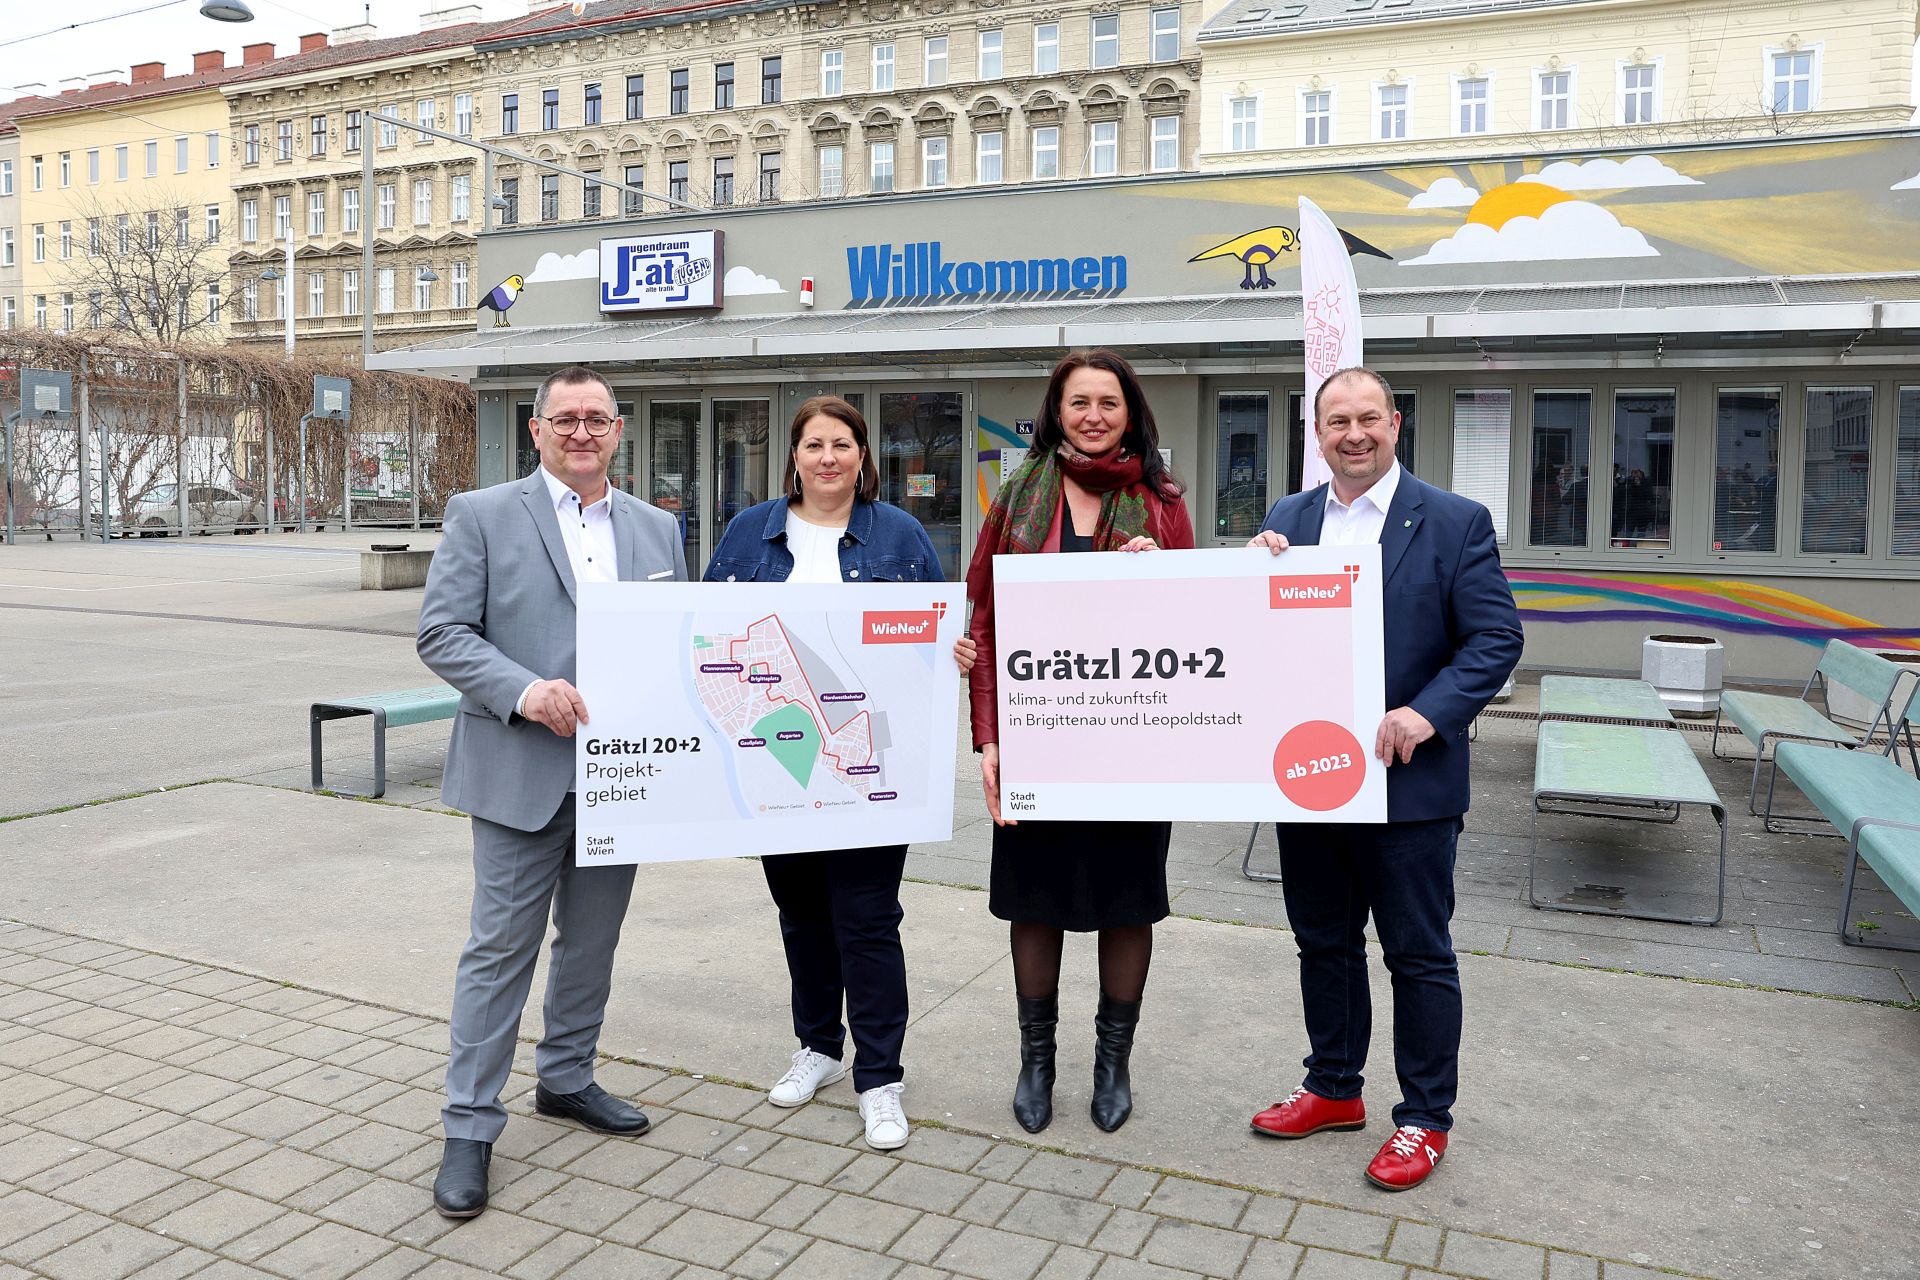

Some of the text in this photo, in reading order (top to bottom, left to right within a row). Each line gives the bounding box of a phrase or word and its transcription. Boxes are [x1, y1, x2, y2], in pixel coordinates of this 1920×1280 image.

[678, 259, 710, 284] JUGEND
[847, 241, 1127, 299] Willkommen
[1019, 424, 1030, 434] 8A
[1279, 584, 1342, 600] WieNeu+
[871, 619, 929, 636] WieNeu+
[1007, 647, 1226, 681] Grätzl 20+2
[823, 692, 863, 701] Nordwestbahnhof
[1009, 691, 1168, 706] klima- und zukunftsfit
[1009, 711, 1243, 730] in Brigittenau und Leopoldstadt
[779, 732, 801, 740] Augarten
[585, 736, 701, 756] Grätzl 20+2
[586, 760, 662, 783] Projekt-
[848, 767, 878, 775] Volkertmarkt
[1286, 753, 1352, 779] ab 2023
[586, 785, 647, 808] gebiet
[1010, 791, 1036, 801] Stadt
[1010, 802, 1036, 811] Wien
[587, 835, 614, 846] Stadt
[587, 847, 614, 856] Wien
